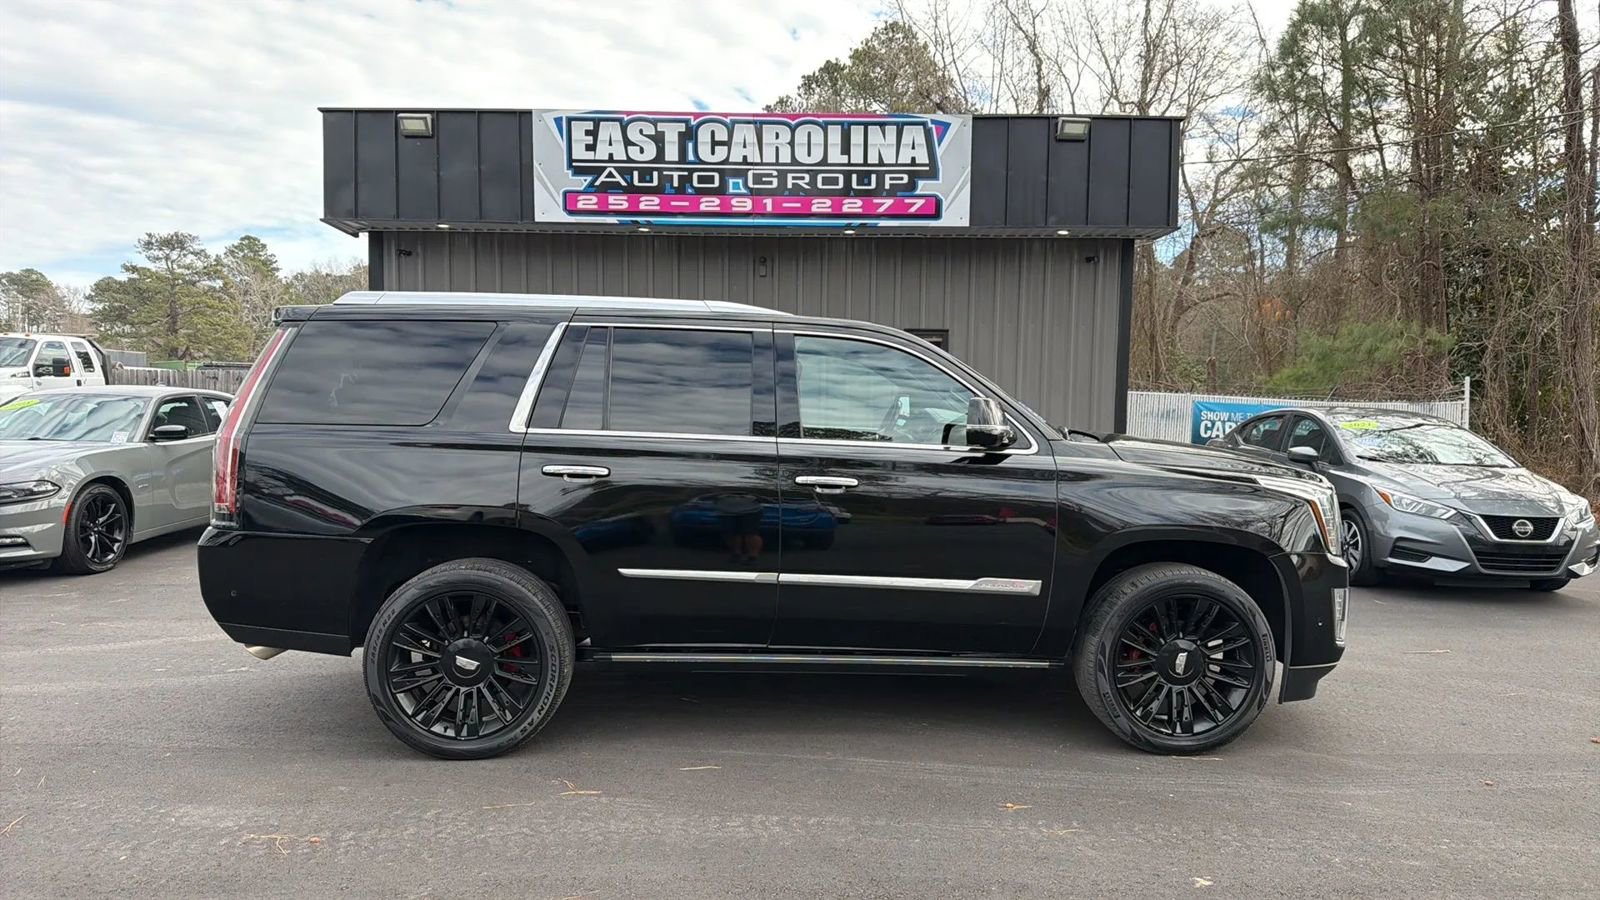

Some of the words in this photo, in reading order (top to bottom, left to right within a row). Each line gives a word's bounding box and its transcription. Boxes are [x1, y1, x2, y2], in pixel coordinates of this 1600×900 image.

[571, 120, 686, 162] EAST
[697, 122, 930, 165] CAROLINA
[594, 167, 720, 188] AUTO
[747, 169, 909, 190] GROUP
[576, 195, 926, 213] 252-291-2277
[1200, 410, 1229, 421] SHOW
[1230, 412, 1245, 422] ME
[537, 643, 558, 717] SCORPION
